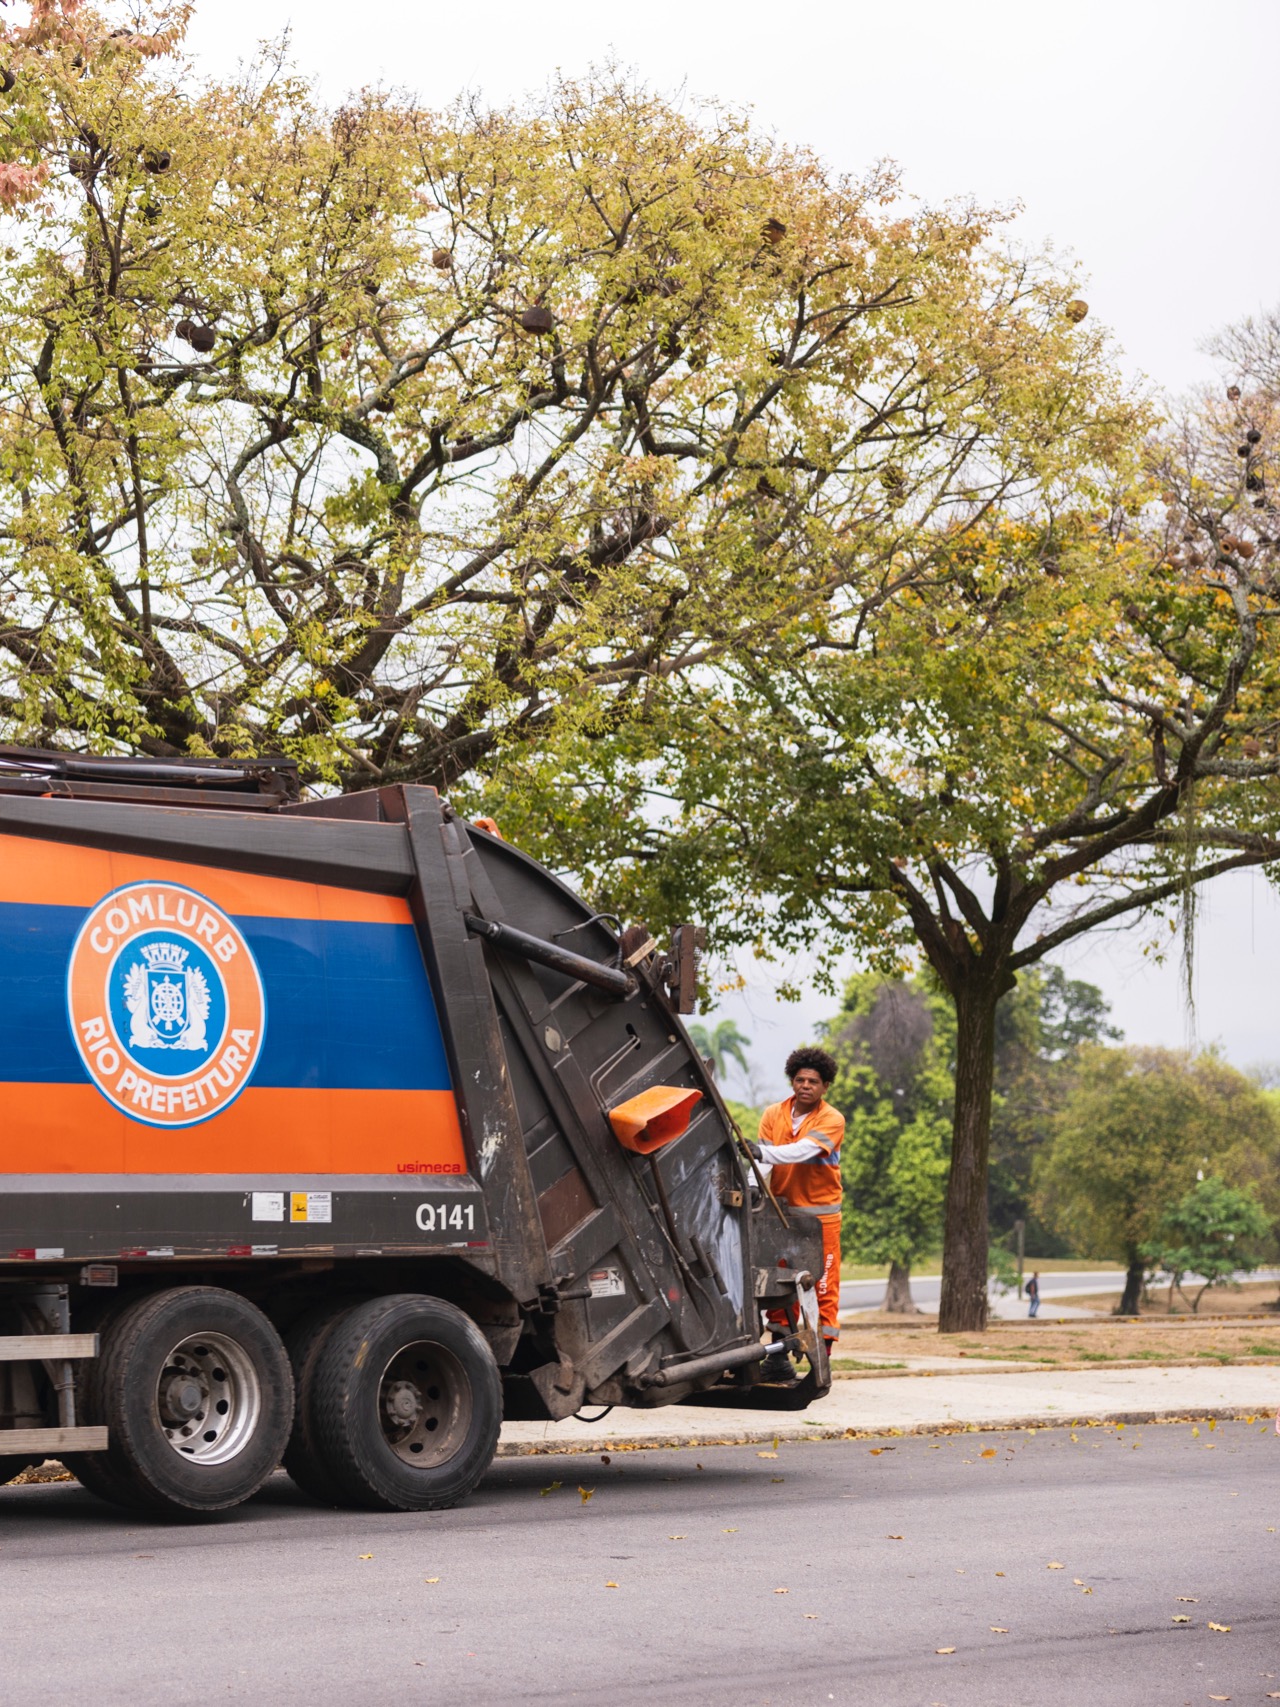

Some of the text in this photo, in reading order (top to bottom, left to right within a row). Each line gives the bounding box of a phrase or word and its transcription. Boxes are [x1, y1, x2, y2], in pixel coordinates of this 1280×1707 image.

[90, 894, 238, 963] COMLURB
[81, 1016, 255, 1113] RIO PREFEITURA
[397, 1160, 461, 1173] usimeca
[416, 1203, 474, 1231] Q141
